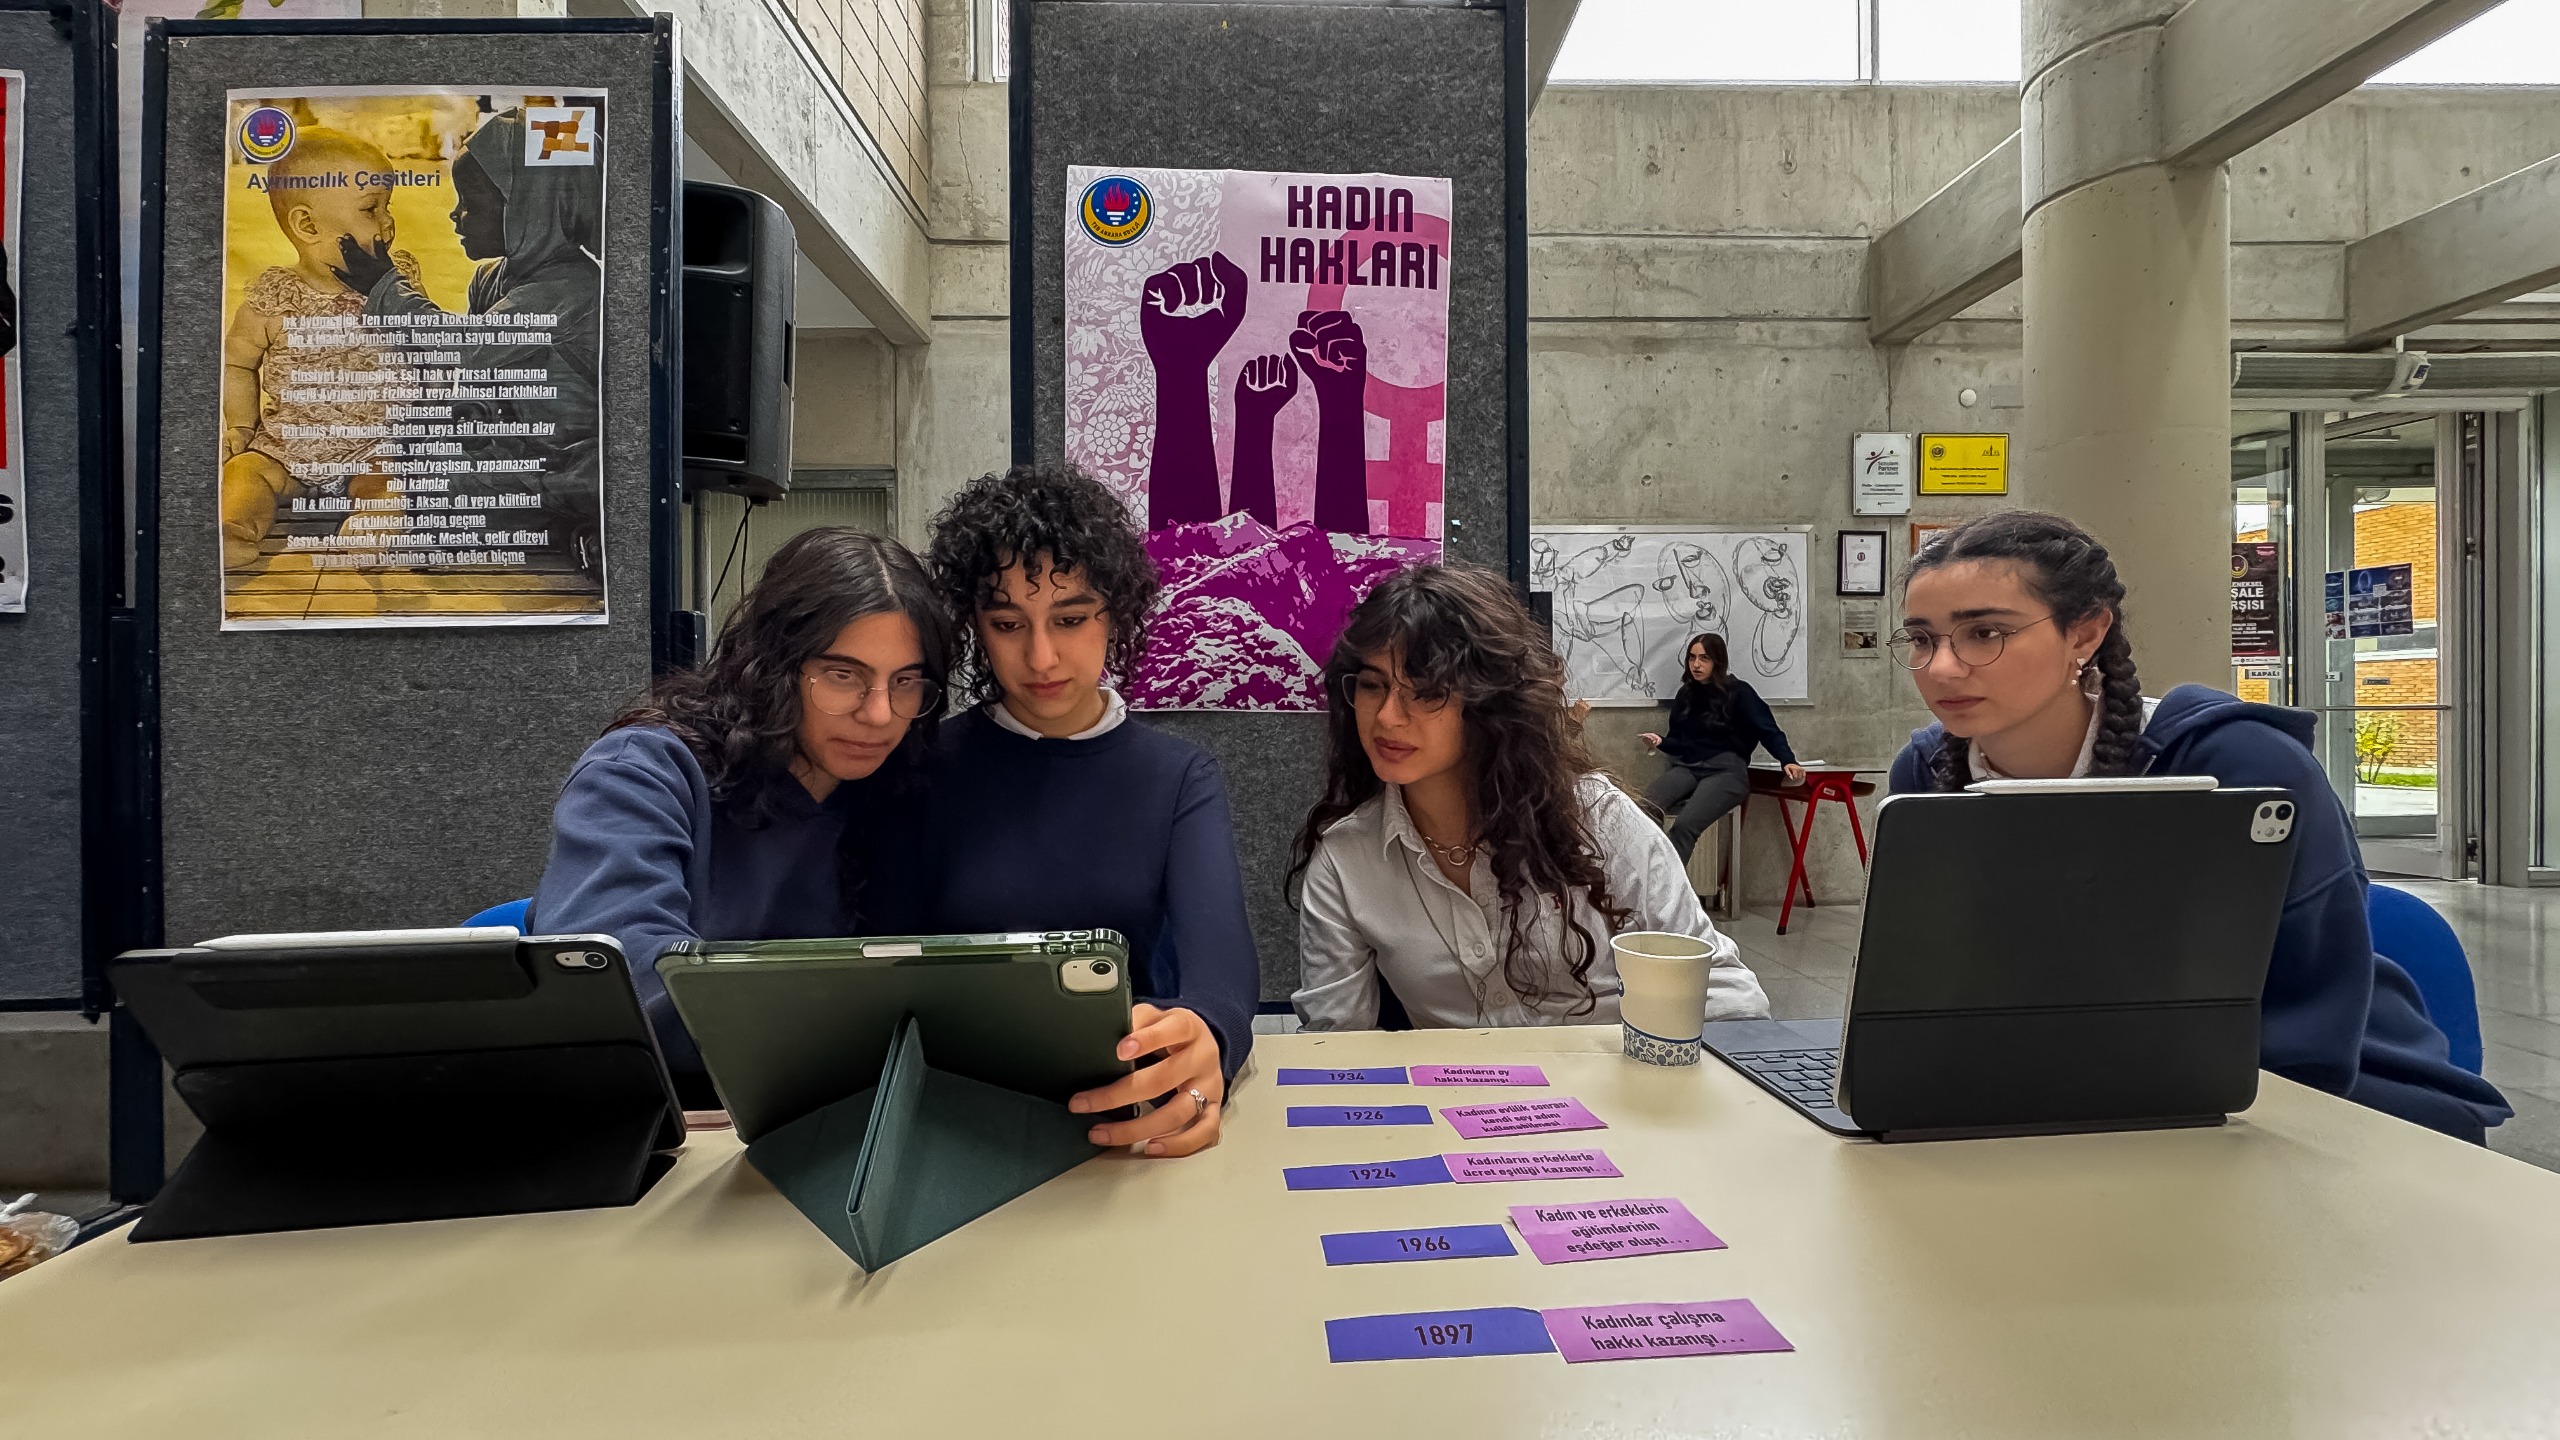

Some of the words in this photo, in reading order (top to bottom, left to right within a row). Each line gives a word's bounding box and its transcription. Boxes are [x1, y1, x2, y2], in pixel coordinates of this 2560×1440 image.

[247, 171, 349, 193] Ayrımcılık
[354, 170, 441, 191] Çeşitleri
[1287, 185, 1414, 234] KADIN
[1260, 236, 1439, 291] HAKLARI
[362, 313, 381, 327] Ten
[383, 312, 411, 328] rengi
[414, 313, 439, 328] veya
[485, 312, 511, 327] göre
[513, 312, 557, 328] dışlama
[411, 329, 462, 347] İnançlara
[465, 330, 495, 346] saygı
[498, 330, 552, 345] duymama
[378, 351, 404, 365] veya
[407, 350, 461, 364] yargılama
[423, 369, 443, 382] hak
[494, 368, 547, 381] tanımama
[426, 387, 452, 401] veya
[499, 385, 557, 399] farklılıkları
[386, 404, 453, 421] küçümseme
[393, 423, 426, 438] Beden
[428, 424, 454, 438] veya
[456, 422, 474, 436] stil
[477, 421, 530, 436] üzerinden
[532, 421, 555, 435] alay
[409, 441, 462, 456] yargılama
[387, 478, 407, 493] gibi
[408, 478, 450, 492] kalıplar
[292, 497, 306, 511] Dil
[308, 499, 316, 511] &
[318, 496, 352, 511] Kültür
[354, 495, 414, 511] Ayrımcılığı:
[416, 495, 453, 509] Aksan,
[454, 494, 468, 508] dil
[471, 494, 496, 508] veya
[499, 493, 541, 507] kültürel
[416, 514, 449, 528] dalga
[449, 514, 486, 530] geçme
[379, 532, 437, 548] Ayrımcılık:
[439, 531, 482, 546] Meslek,
[485, 530, 510, 546] gelir
[513, 530, 549, 545] düzeyi
[378, 551, 426, 567] biçimine
[428, 550, 454, 565] göre
[456, 549, 488, 564] değer
[490, 549, 526, 566] biçme
[1329, 1072, 1365, 1081] 1934
[1443, 1068, 1495, 1076] Kadınların
[1344, 1110, 1384, 1121] 1926
[1456, 1108, 1497, 1118] Kadının
[1498, 1105, 1530, 1115] evlilik
[1531, 1102, 1570, 1111] sonrası
[1481, 1115, 1513, 1125] kendi
[1513, 1115, 1533, 1124] soy
[1534, 1113, 1562, 1121] adını
[1467, 1155, 1531, 1166] Kadınların
[1532, 1152, 1595, 1164] erkeklerle
[1349, 1167, 1397, 1181] 1924
[1463, 1168, 1497, 1177] ücret
[1498, 1166, 1541, 1178] eşitliği
[1535, 1208, 1578, 1223] Kadın
[1577, 1208, 1597, 1220] ve
[1598, 1202, 1669, 1218] erkeklerin
[1571, 1220, 1661, 1239] eğitimlerinin
[1396, 1235, 1451, 1253] 1966
[1567, 1240, 1625, 1254] eşdeğer
[1581, 1313, 1654, 1330] Kadınlar
[1657, 1311, 1726, 1330] çalışma
[1413, 1323, 1473, 1346] 1897
[1590, 1334, 1644, 1351] hakkı
